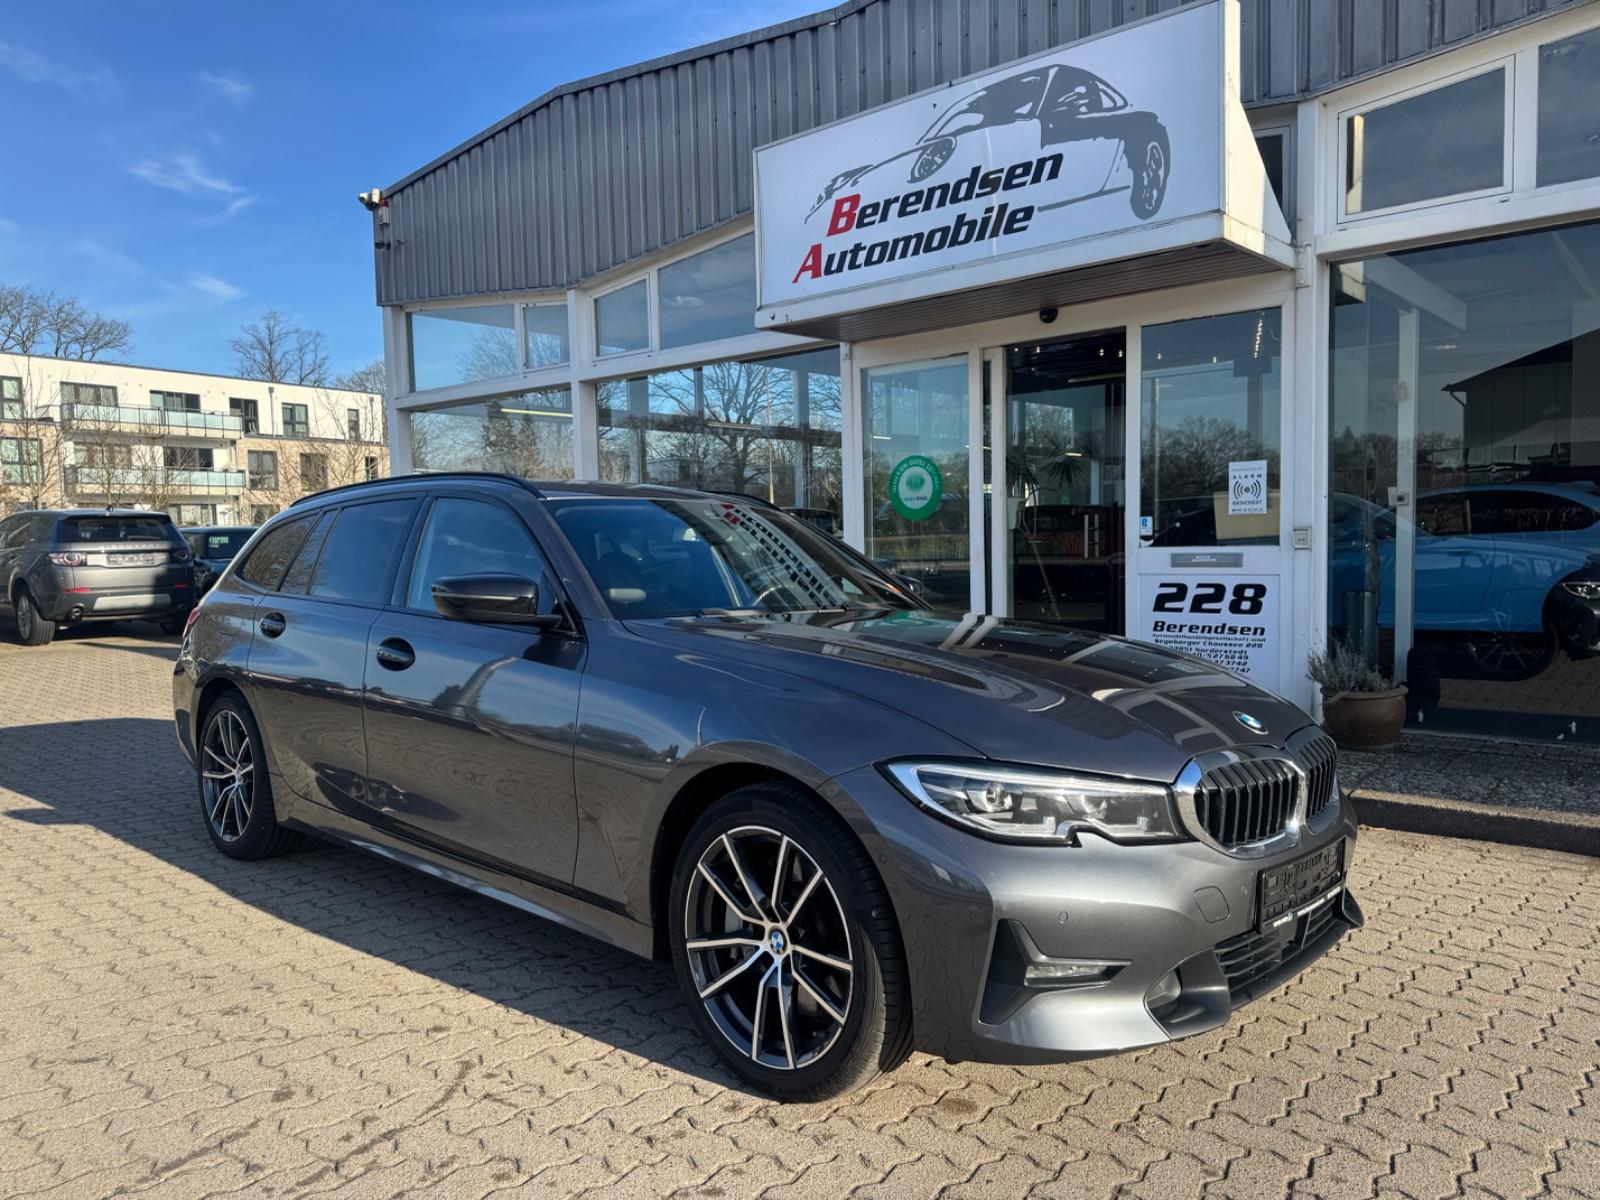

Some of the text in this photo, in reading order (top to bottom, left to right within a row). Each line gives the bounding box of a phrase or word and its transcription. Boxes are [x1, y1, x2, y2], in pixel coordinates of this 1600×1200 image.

[826, 153, 1063, 236] Berendsen
[792, 203, 1035, 283] Automobile
[1152, 582, 1267, 615] 228
[1152, 620, 1266, 636] Berendsen
[1195, 647, 1247, 655] Norderstedt
[1203, 640, 1244, 648] Chaussee
